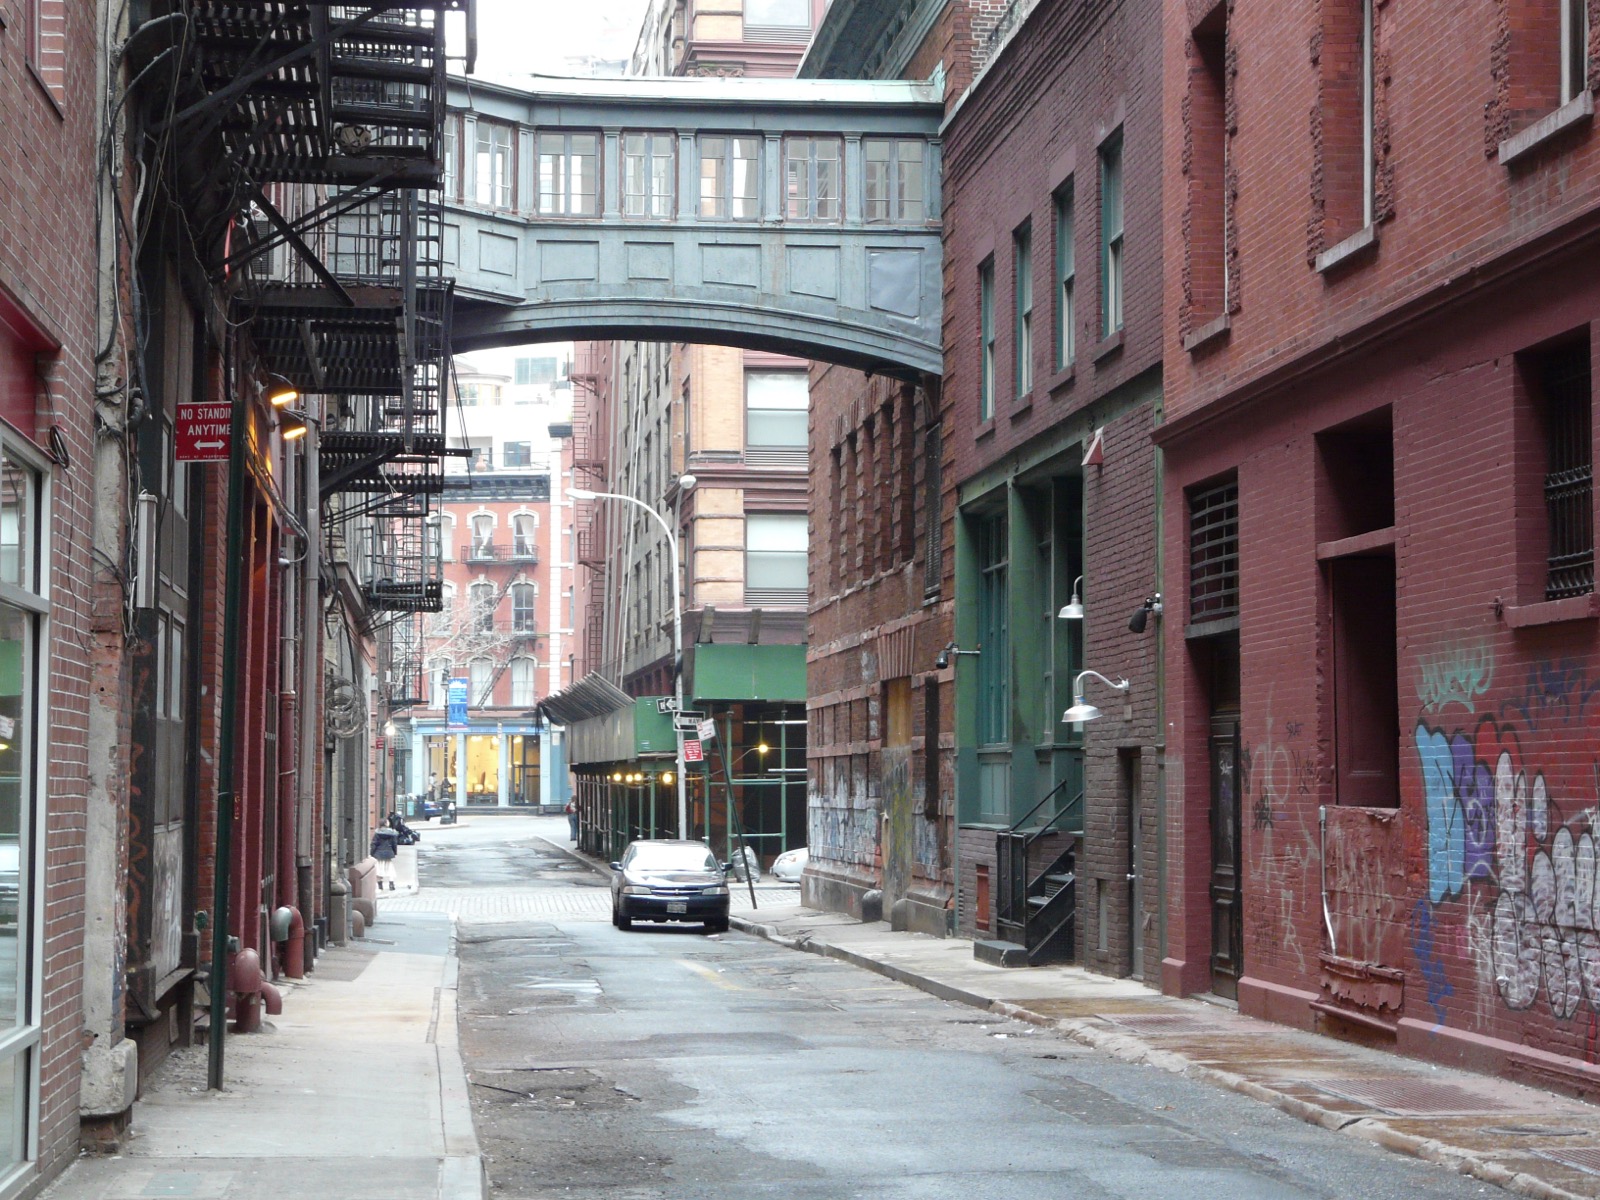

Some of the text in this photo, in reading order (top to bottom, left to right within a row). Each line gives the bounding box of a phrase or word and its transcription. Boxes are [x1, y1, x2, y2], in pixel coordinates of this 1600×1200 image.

[180, 407, 232, 421] NO STANDIN
[187, 424, 232, 436] ANYTIME
